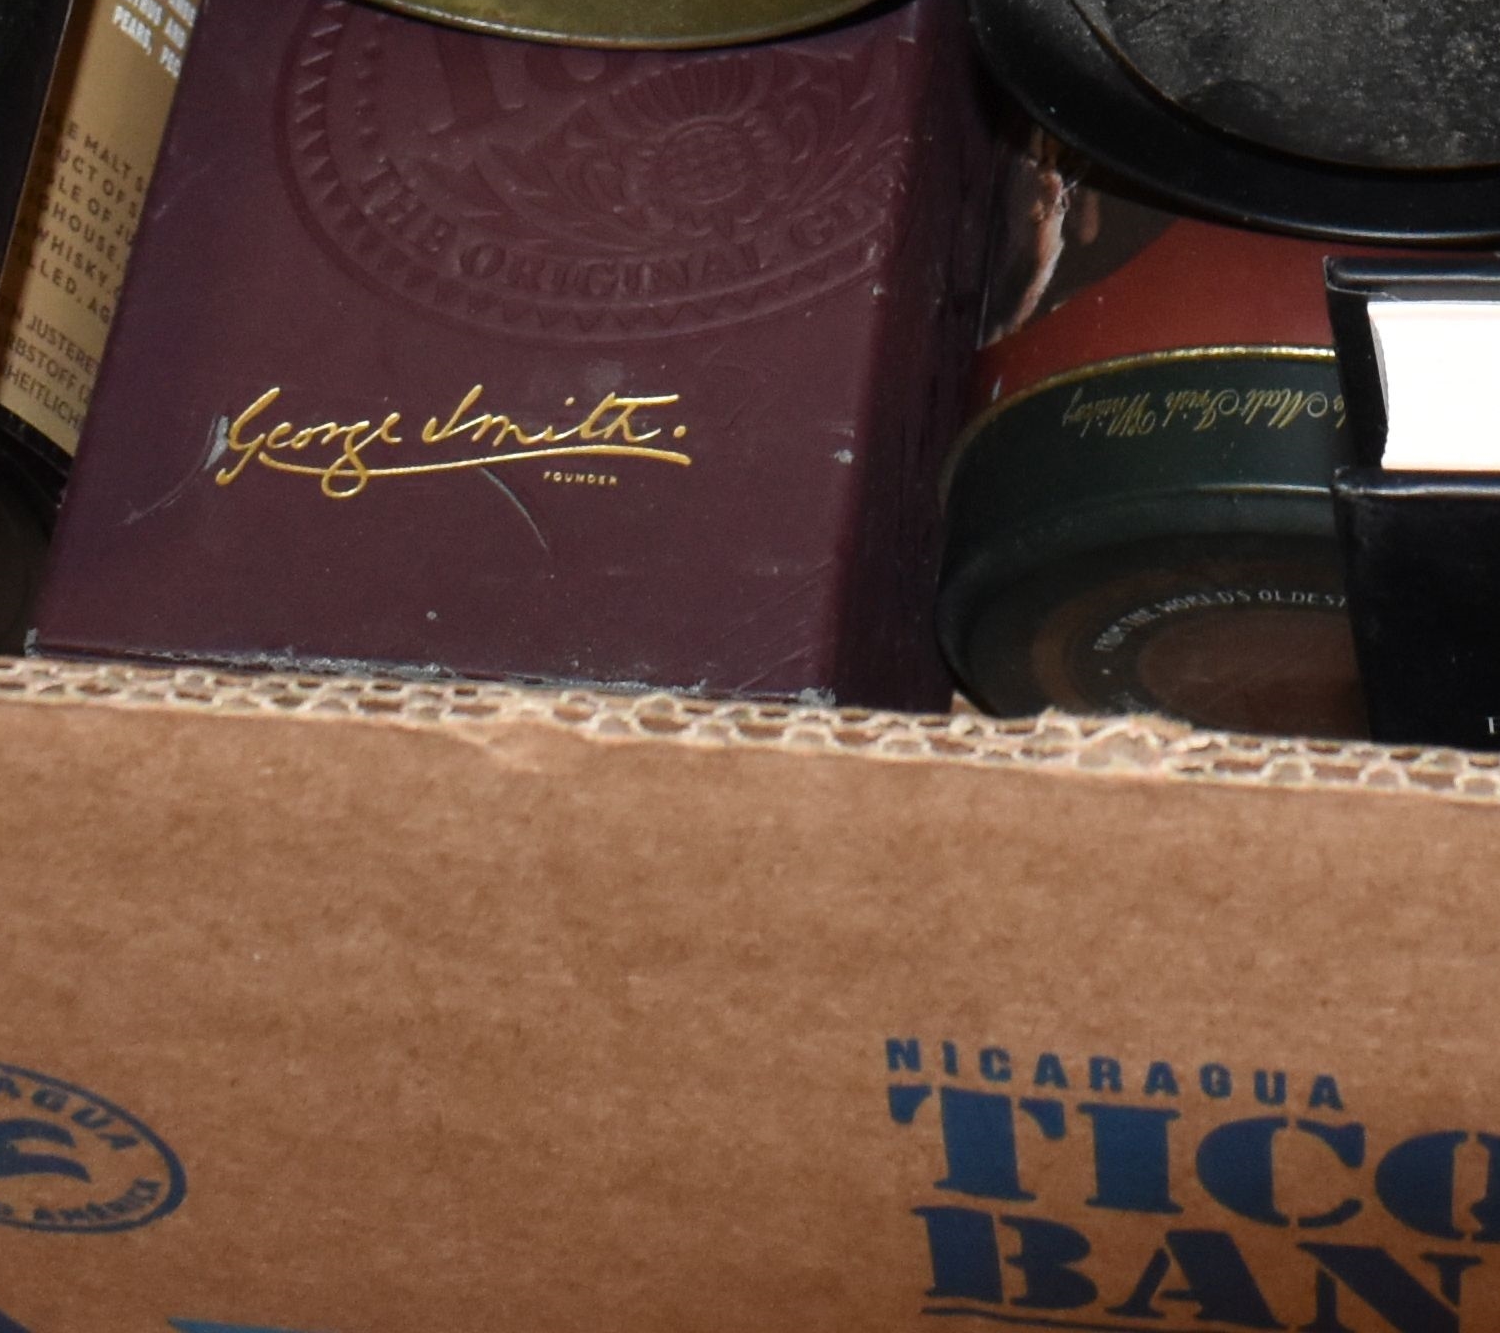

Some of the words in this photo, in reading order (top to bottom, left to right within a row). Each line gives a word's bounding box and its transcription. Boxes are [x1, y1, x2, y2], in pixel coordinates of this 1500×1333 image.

[83, 134, 133, 181] MALT
[1161, 387, 1240, 431] Irish
[1239, 387, 1329, 431] Malt
[214, 386, 403, 500] George
[541, 468, 620, 488] FOUNDER
[885, 1038, 1346, 1111] NICARAGUA
